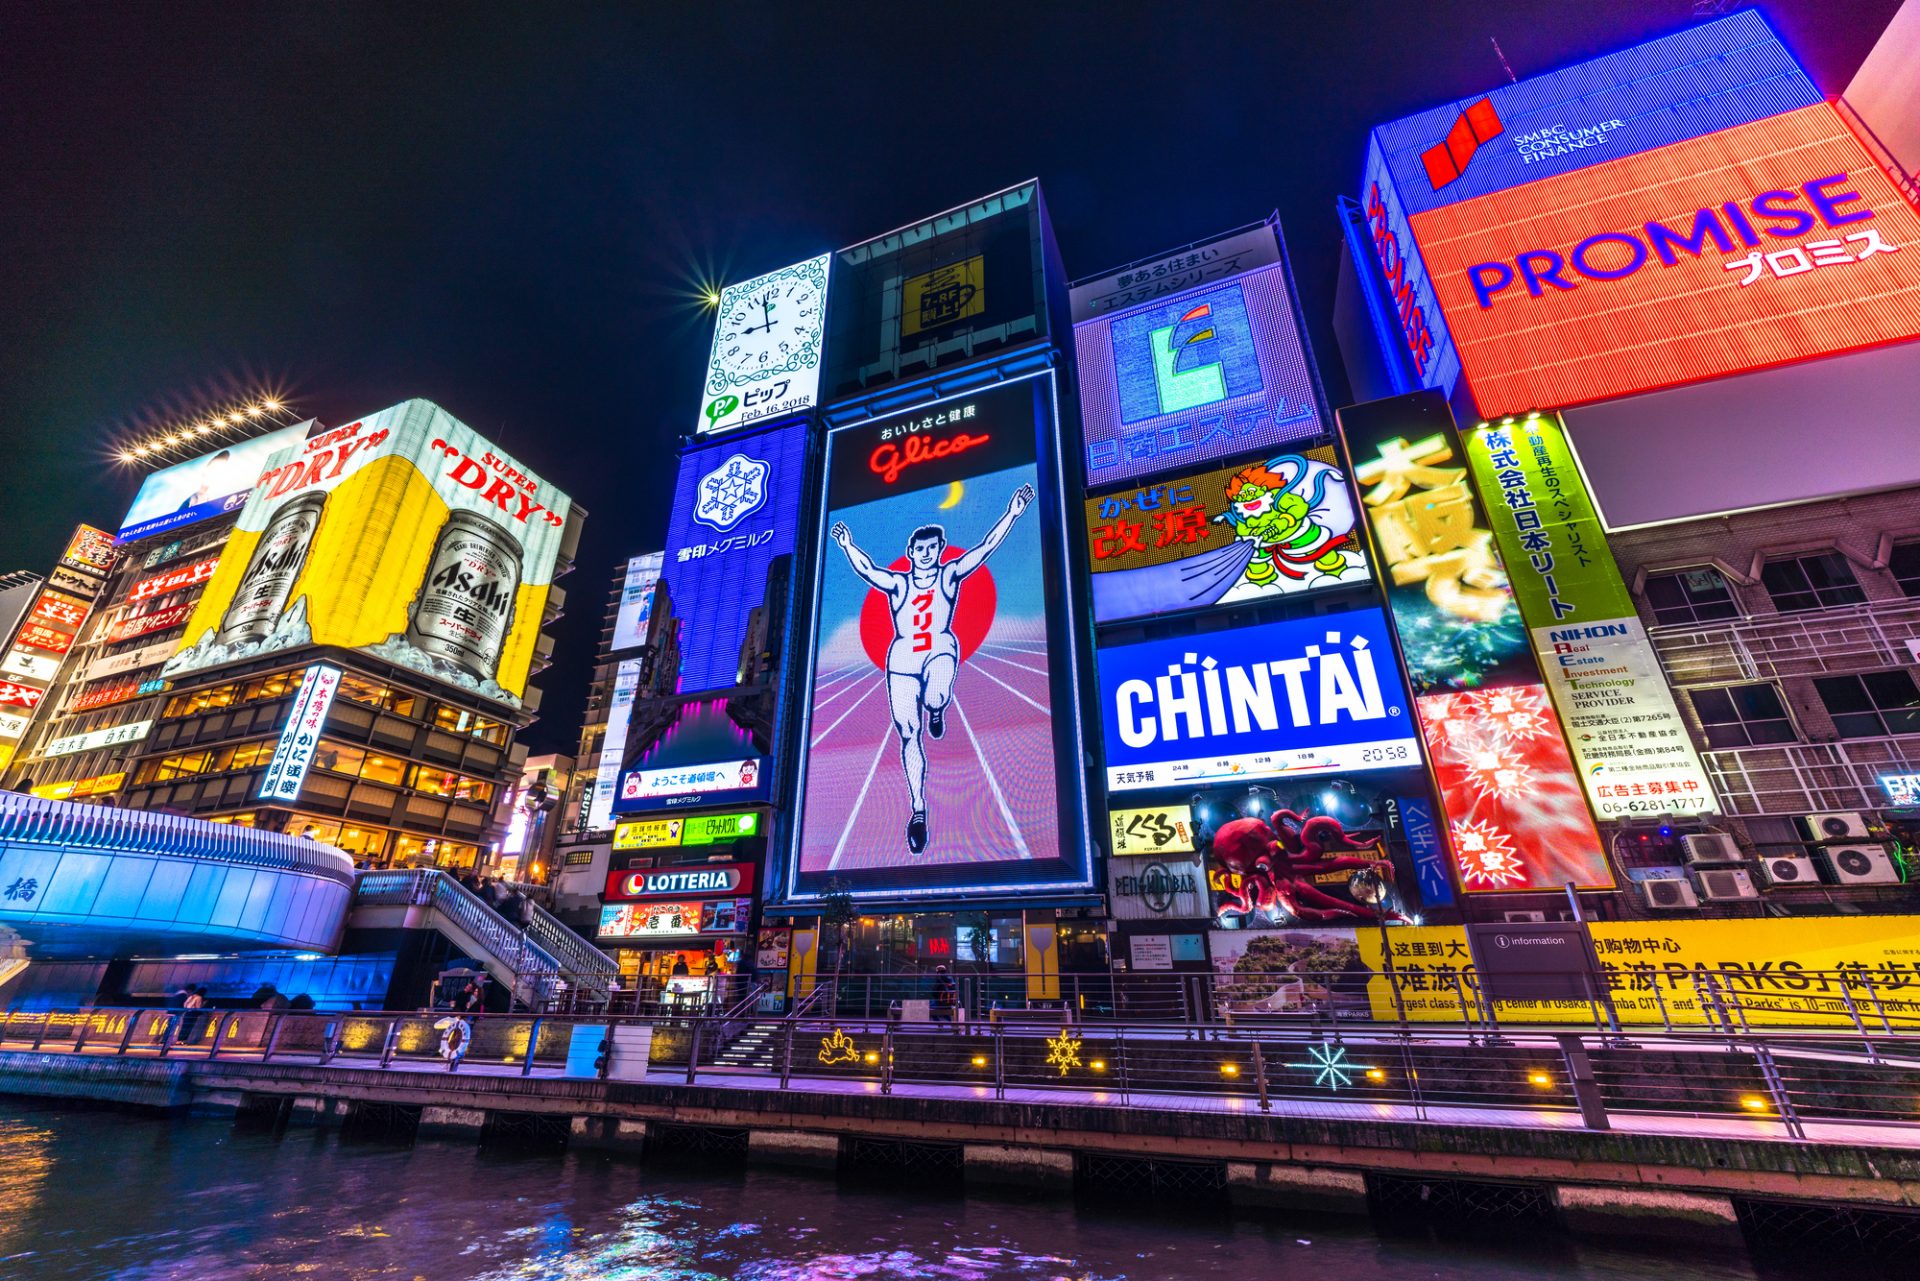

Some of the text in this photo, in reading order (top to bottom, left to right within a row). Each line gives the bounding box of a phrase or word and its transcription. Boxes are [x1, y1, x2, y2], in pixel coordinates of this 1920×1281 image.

[1514, 124, 1567, 146] SMBC
[1518, 119, 1626, 154] CONSUMER
[1523, 134, 1608, 164] FINANCE
[1468, 173, 1875, 309] PROMISE
[1725, 229, 1898, 286] プロミス
[1117, 249, 1219, 289] 夢ある住まい
[1367, 181, 1432, 377] PROMISE
[765, 288, 780, 300] 12
[786, 287, 795, 298] 1
[1104, 258, 1242, 310] エステムシリーズ
[747, 297, 760, 310] 11
[796, 293, 809, 305] 2
[731, 312, 747, 327] 10
[800, 307, 813, 317] 3
[724, 332, 737, 342] 9
[794, 325, 805, 336] 4
[727, 346, 740, 357] 8
[758, 351, 769, 363] 6
[779, 341, 789, 353] 5
[740, 353, 753, 364] 7
[743, 379, 791, 407] ピップ
[741, 409, 763, 421] Feb.
[782, 394, 810, 410] 2018
[881, 405, 976, 440] おいしさと健康
[1088, 397, 1313, 470] 日商エステム
[304, 422, 362, 454] SUPER
[869, 433, 991, 484] Glico
[481, 452, 538, 494] SUPER
[1098, 484, 1195, 519] かぜに
[1092, 504, 1210, 559] 改源
[1485, 431, 1575, 621] 株式会社日本リート
[677, 529, 774, 563] 雪印メグミルク
[244, 540, 307, 586] Asahi
[254, 584, 273, 600] 生
[432, 561, 509, 617] Asahi
[453, 606, 476, 627] 生
[911, 589, 935, 652] グリコ
[440, 618, 482, 641] スーパードライ
[1550, 624, 1628, 642] NIHON
[1554, 643, 1590, 654] Real
[1559, 654, 1604, 667] Estate
[1563, 666, 1628, 679] Investment
[1115, 631, 1387, 748] CHINTAI
[1565, 678, 1635, 691] Technology
[1571, 689, 1622, 700] SERVICE
[1489, 695, 1532, 730] 激安
[1574, 697, 1635, 709] PROVIDER
[280, 688, 328, 794] 本場の味 かに道楽
[1598, 729, 1678, 742] 全日本不動産協会
[651, 772, 726, 788] ようこそ道頓堀へ
[1116, 770, 1155, 784] 天気予報
[1597, 779, 1699, 798] 広告主募集中
[1386, 799, 1398, 828] 2F
[1602, 797, 1706, 814] 06-6281-1717
[1126, 813, 1177, 846] くくる
[1463, 831, 1505, 871] 激安
[4, 877, 39, 902] 橋
[648, 872, 728, 891] LOTTERIA
[1511, 936, 1565, 945] information
[1391, 998, 1429, 1011] Lrgest
